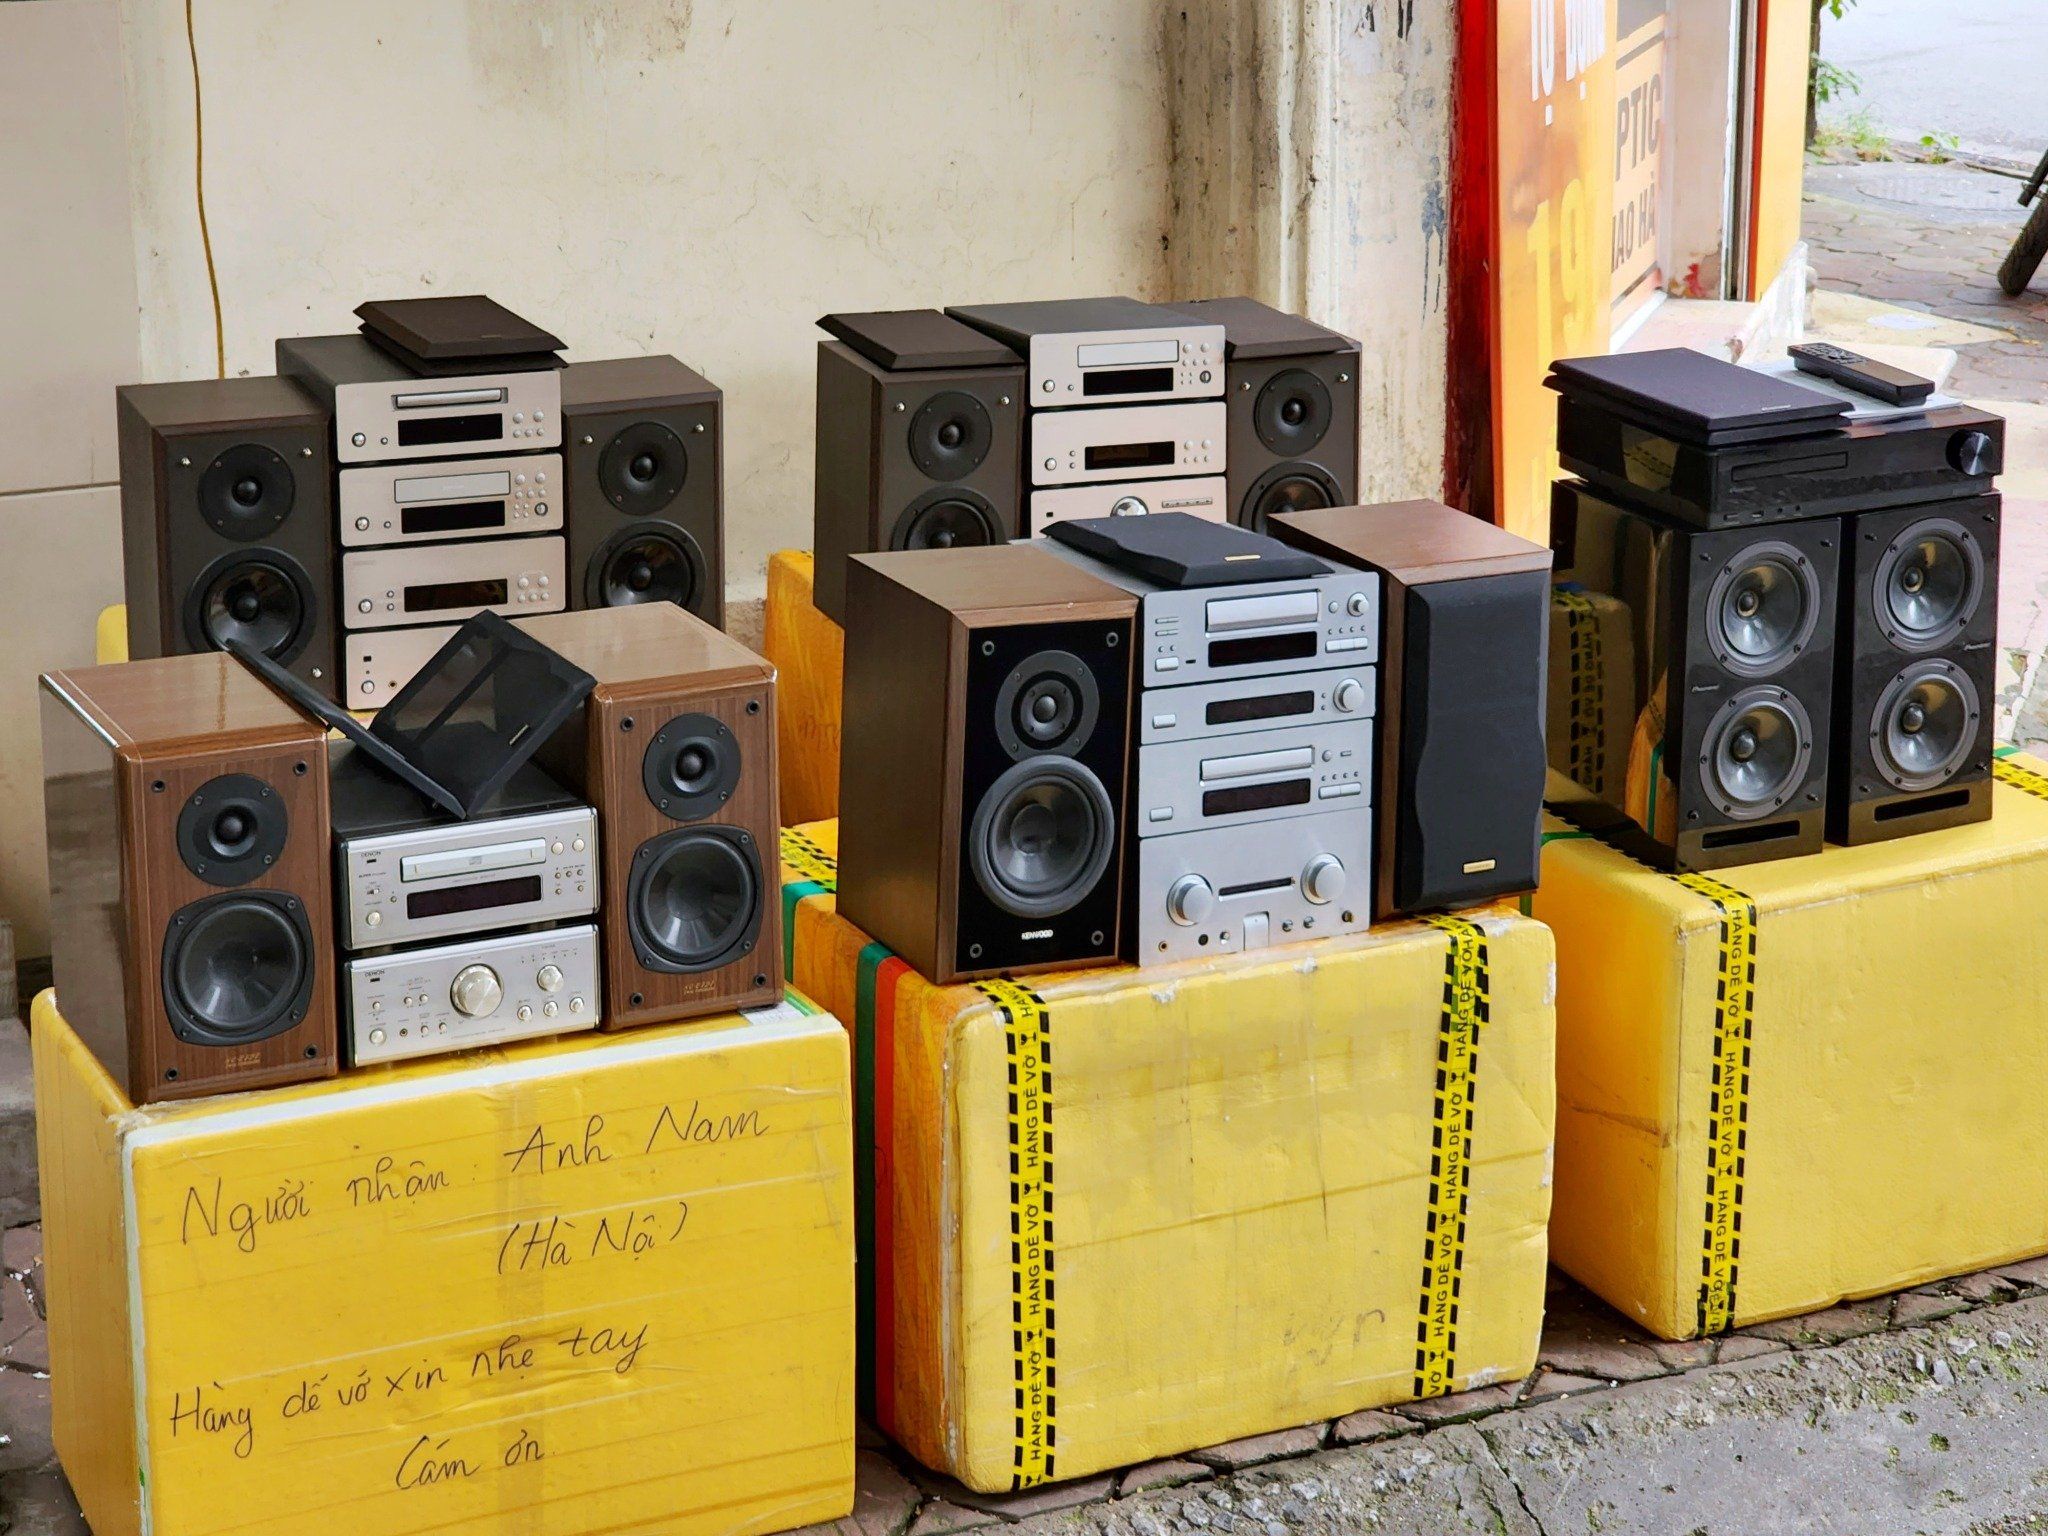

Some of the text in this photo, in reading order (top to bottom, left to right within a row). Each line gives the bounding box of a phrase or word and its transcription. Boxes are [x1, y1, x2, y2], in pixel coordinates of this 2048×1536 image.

[1723, 1052, 1738, 1099] HÀNG
[503, 1114, 614, 1175] Anh
[645, 1100, 770, 1154] Nam
[1024, 1115, 1039, 1168] HÀNG
[498, 1216, 576, 1275] (Hà
[1027, 1262, 1040, 1316] HÀNG
[170, 1380, 253, 1458] Hàng
[386, 1358, 448, 1397] xin
[471, 1335, 534, 1379] nhẹ
[557, 1323, 648, 1374] tay
[1027, 1410, 1041, 1461] HÀNG
